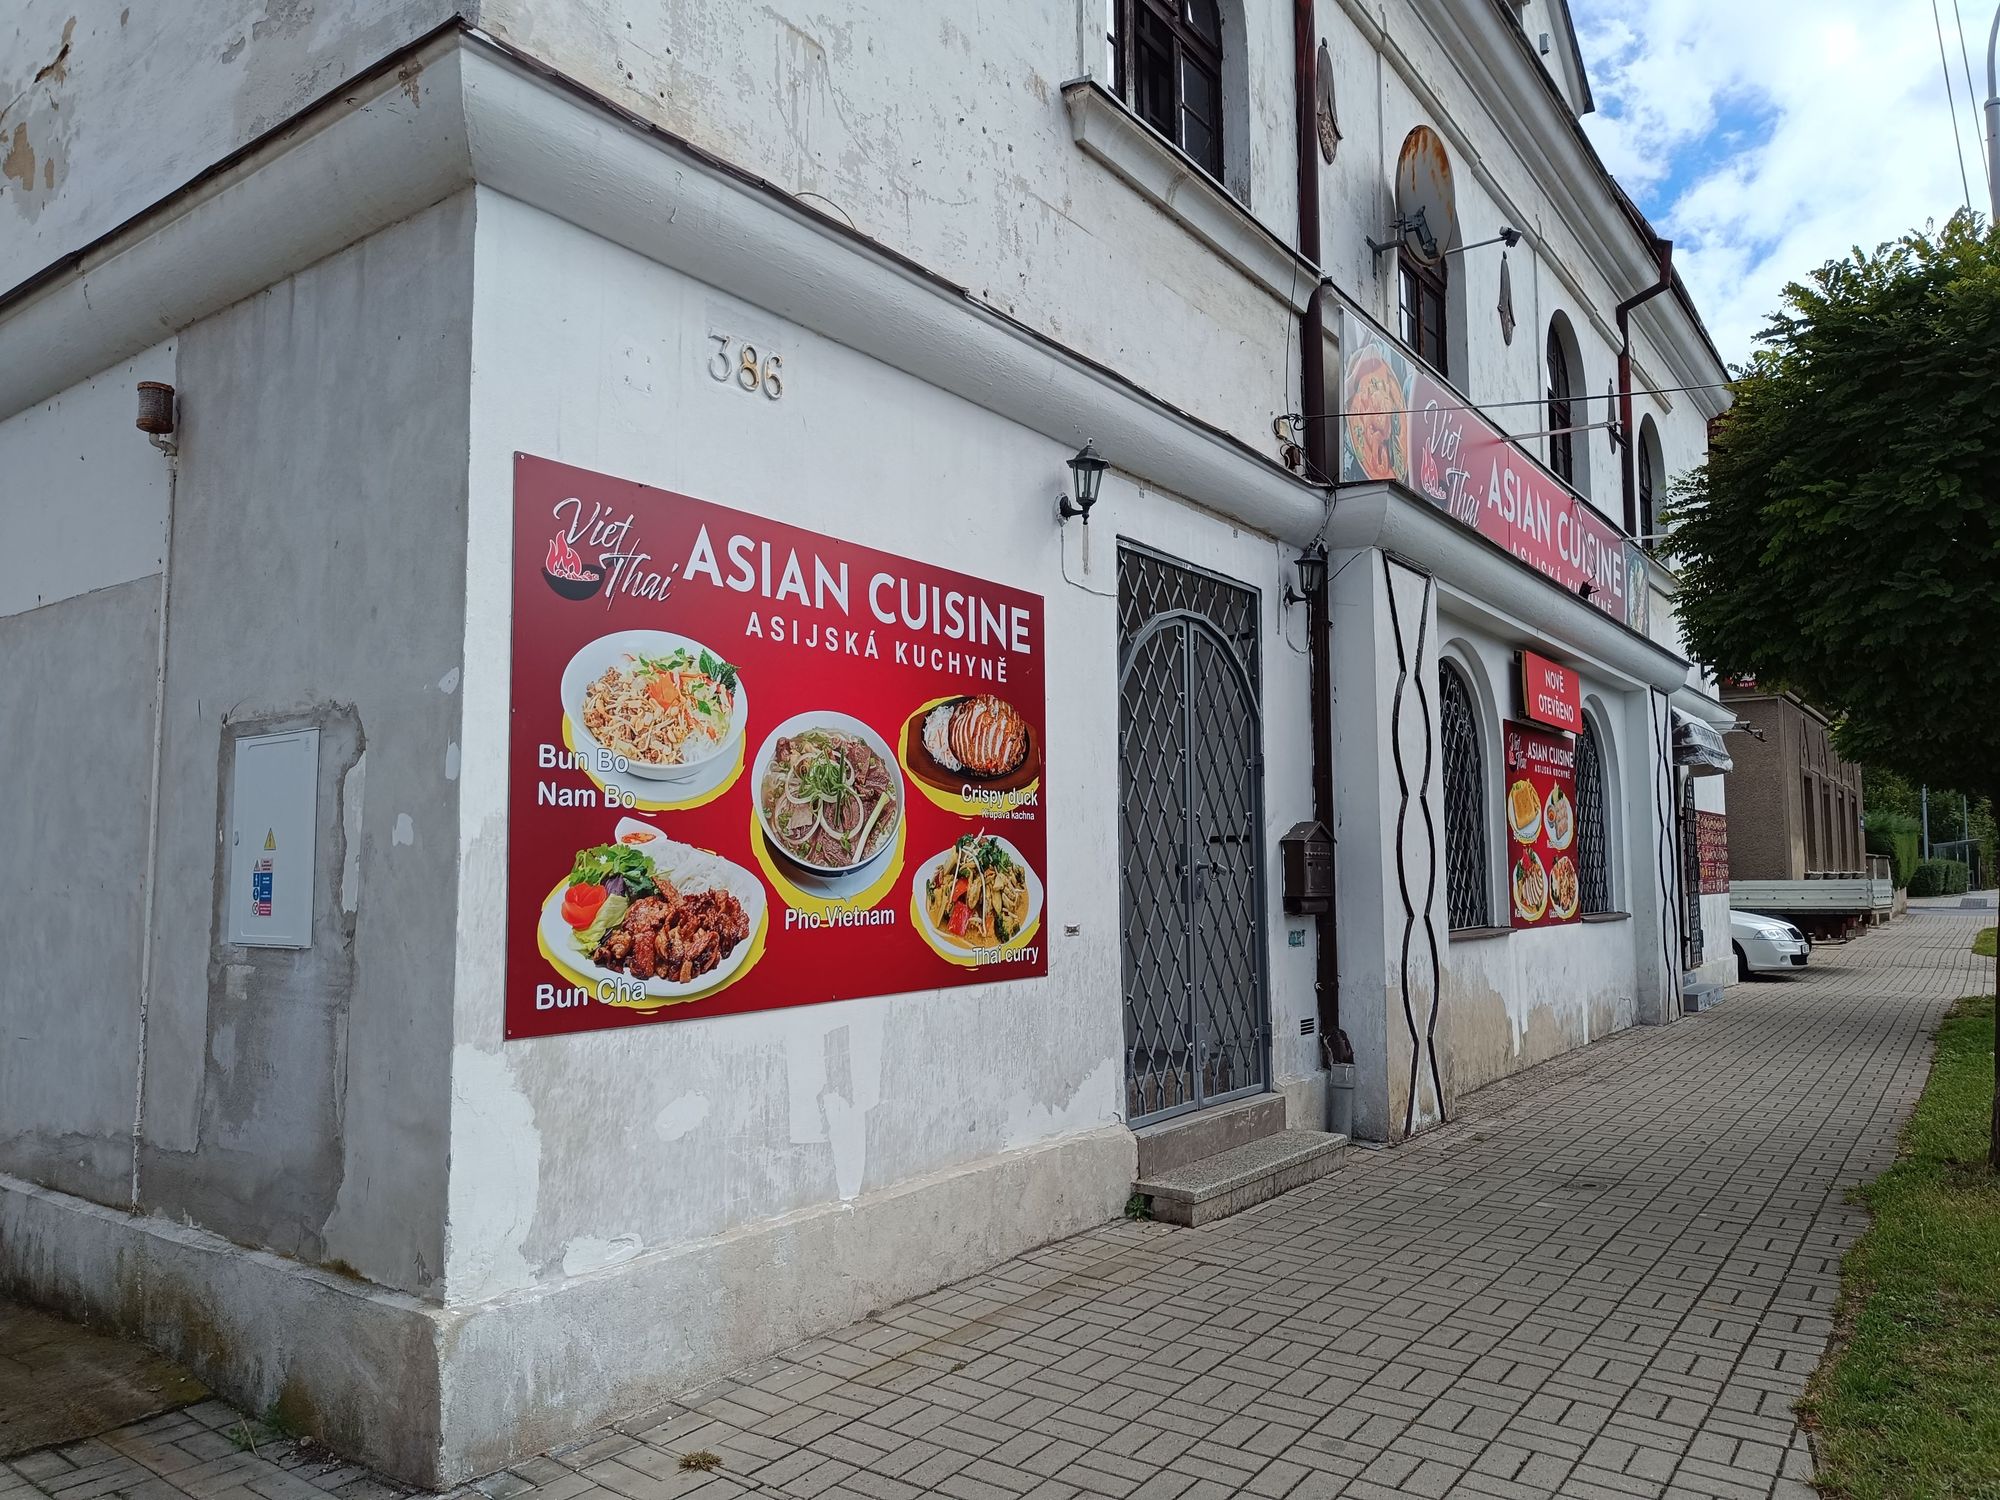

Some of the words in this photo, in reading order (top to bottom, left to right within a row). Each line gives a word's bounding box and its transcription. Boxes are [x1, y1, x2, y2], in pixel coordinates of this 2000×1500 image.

[708, 328, 783, 401] 386
[1424, 399, 1462, 466] Viet
[1445, 453, 1483, 528] Thai
[553, 497, 634, 562] Viet
[1487, 456, 1551, 550] ASIAN
[1557, 511, 1622, 598] CUISINE
[599, 538, 680, 612] Thai
[683, 522, 850, 616] ASIAN
[869, 572, 1032, 655] CUISINE
[745, 611, 880, 660] ASIJSKÁ
[895, 641, 1008, 683] KUCHYNĚ
[1538, 693, 1574, 723] OTEVŘENO
[538, 743, 590, 771] Bun
[597, 747, 630, 773] Bo
[1528, 741, 1548, 762] ASIAN
[1549, 747, 1574, 768] CUISINE
[537, 781, 596, 808] Nam
[603, 785, 637, 810] Bo
[961, 783, 1005, 808] Crispy
[1008, 787, 1038, 807] duck
[1011, 810, 1035, 821] kachna
[785, 906, 821, 931] Pho
[825, 906, 895, 928] Vietnam
[972, 946, 1002, 966] Thai
[1005, 945, 1039, 965] curry
[536, 983, 588, 1010] Bun
[596, 977, 647, 1005] Cha
